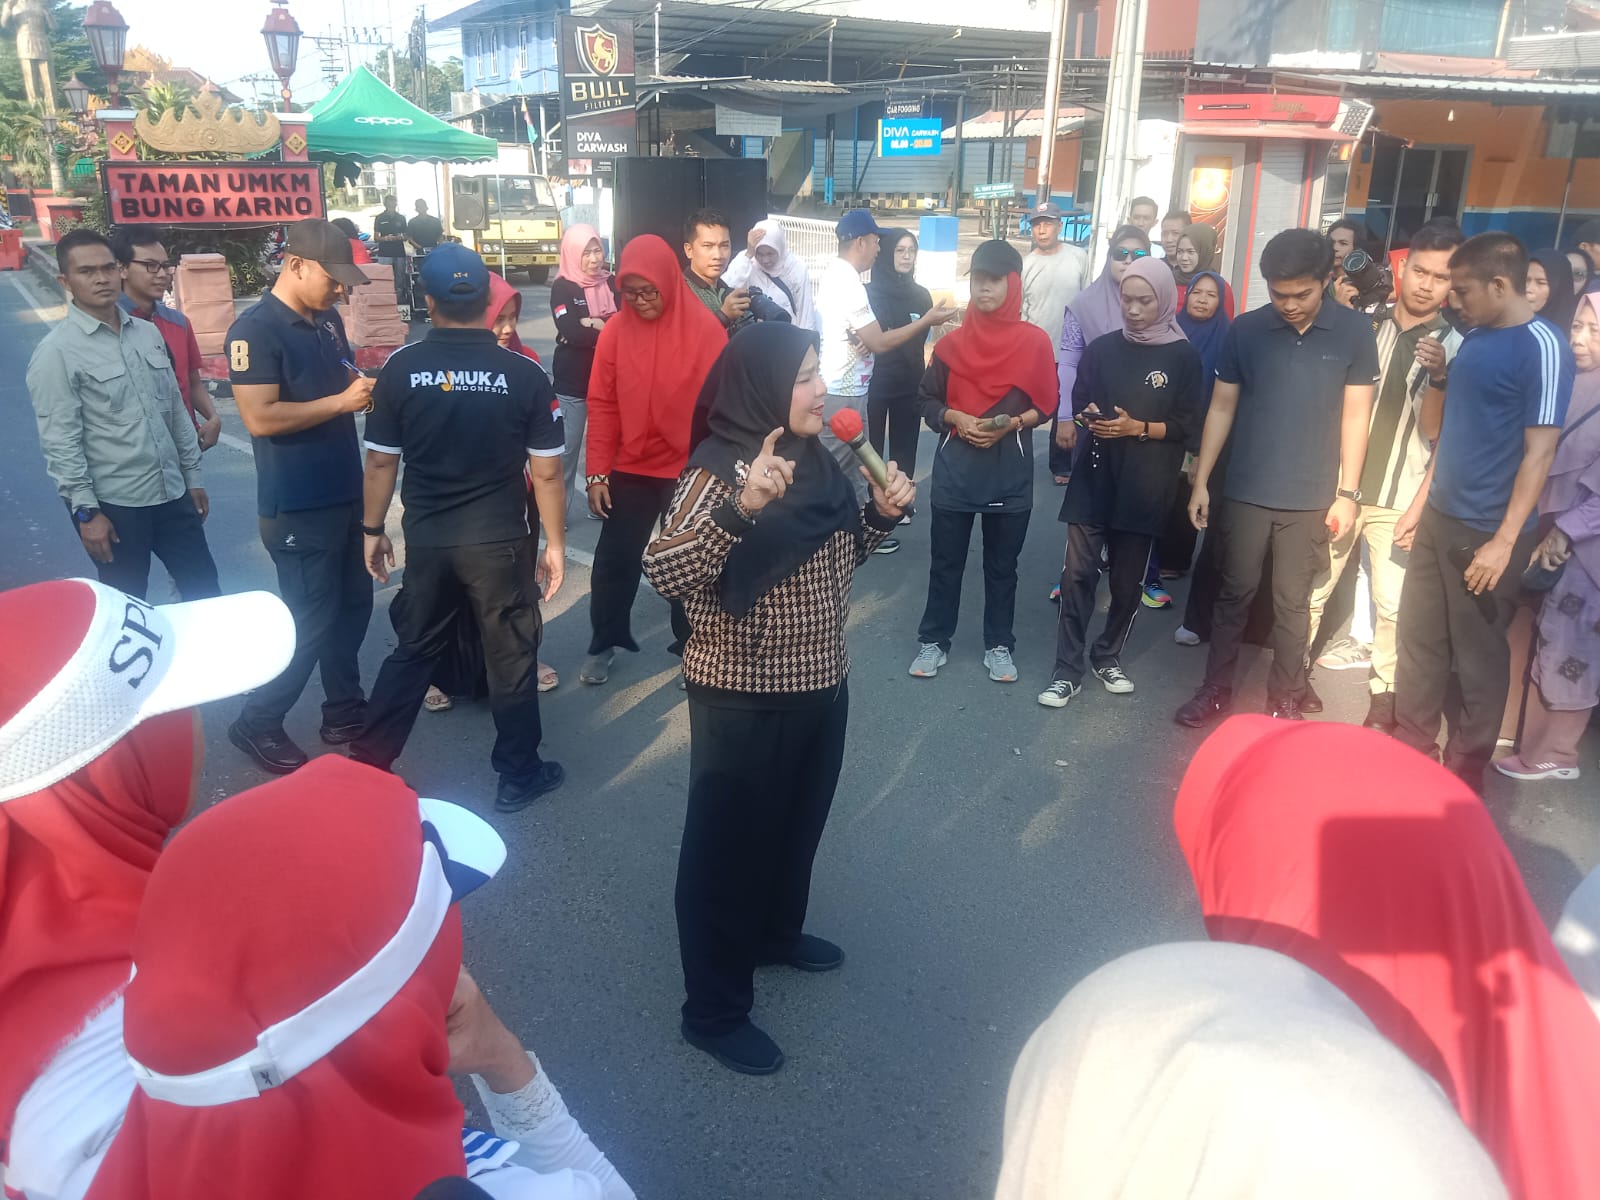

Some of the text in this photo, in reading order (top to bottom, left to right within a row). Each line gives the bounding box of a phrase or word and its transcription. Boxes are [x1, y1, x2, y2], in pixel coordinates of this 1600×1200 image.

[570, 80, 630, 102] BULL
[585, 100, 611, 111] FILTER
[576, 131, 602, 142] DIVA
[883, 126, 910, 137] DIVA
[576, 143, 628, 153] CARWASH
[118, 173, 310, 193] TAMAN UMKM
[121, 197, 313, 218] BUNG KARNO
[230, 339, 250, 372] 8
[410, 370, 509, 388] PRAMUKA
[451, 385, 509, 395] INDONESIA
